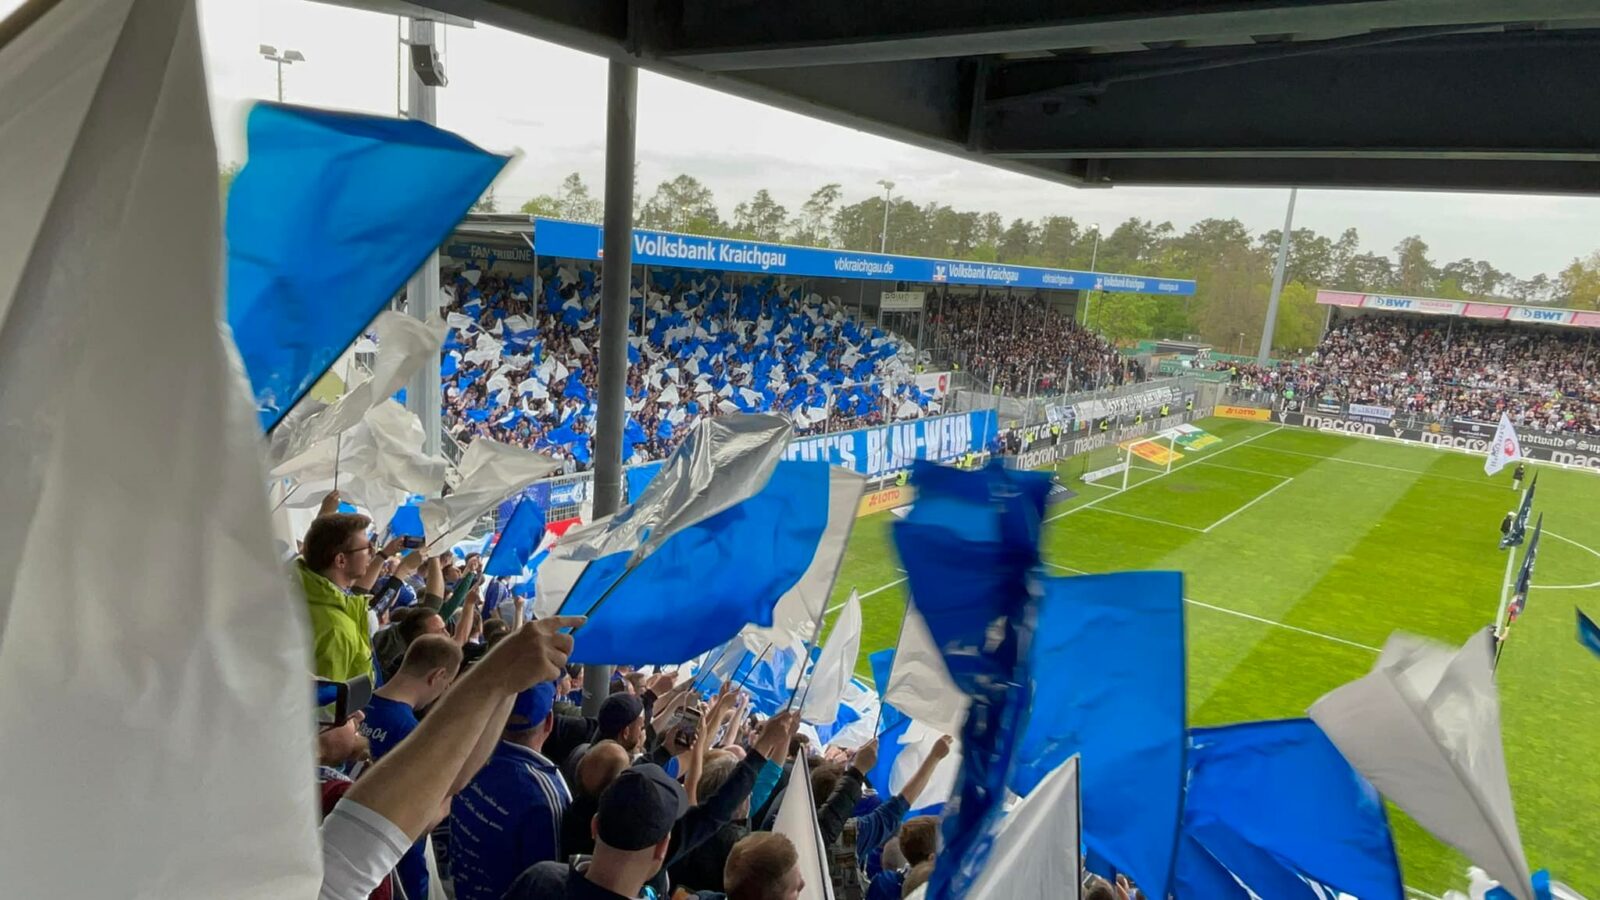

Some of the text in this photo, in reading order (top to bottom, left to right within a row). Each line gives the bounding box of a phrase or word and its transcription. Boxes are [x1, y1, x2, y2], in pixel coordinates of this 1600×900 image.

[634, 235, 787, 270] Volksbank Kraichgau
[834, 260, 894, 275] vbkraichgau.de
[949, 264, 1019, 283] Volksbank Kraichgau
[1385, 299, 1412, 309] BWT
[1534, 311, 1563, 321] BWT
[1303, 414, 1376, 435] macron
[1073, 434, 1105, 455] macron
[1016, 447, 1054, 469] macron
[879, 490, 900, 503] LOTTO
